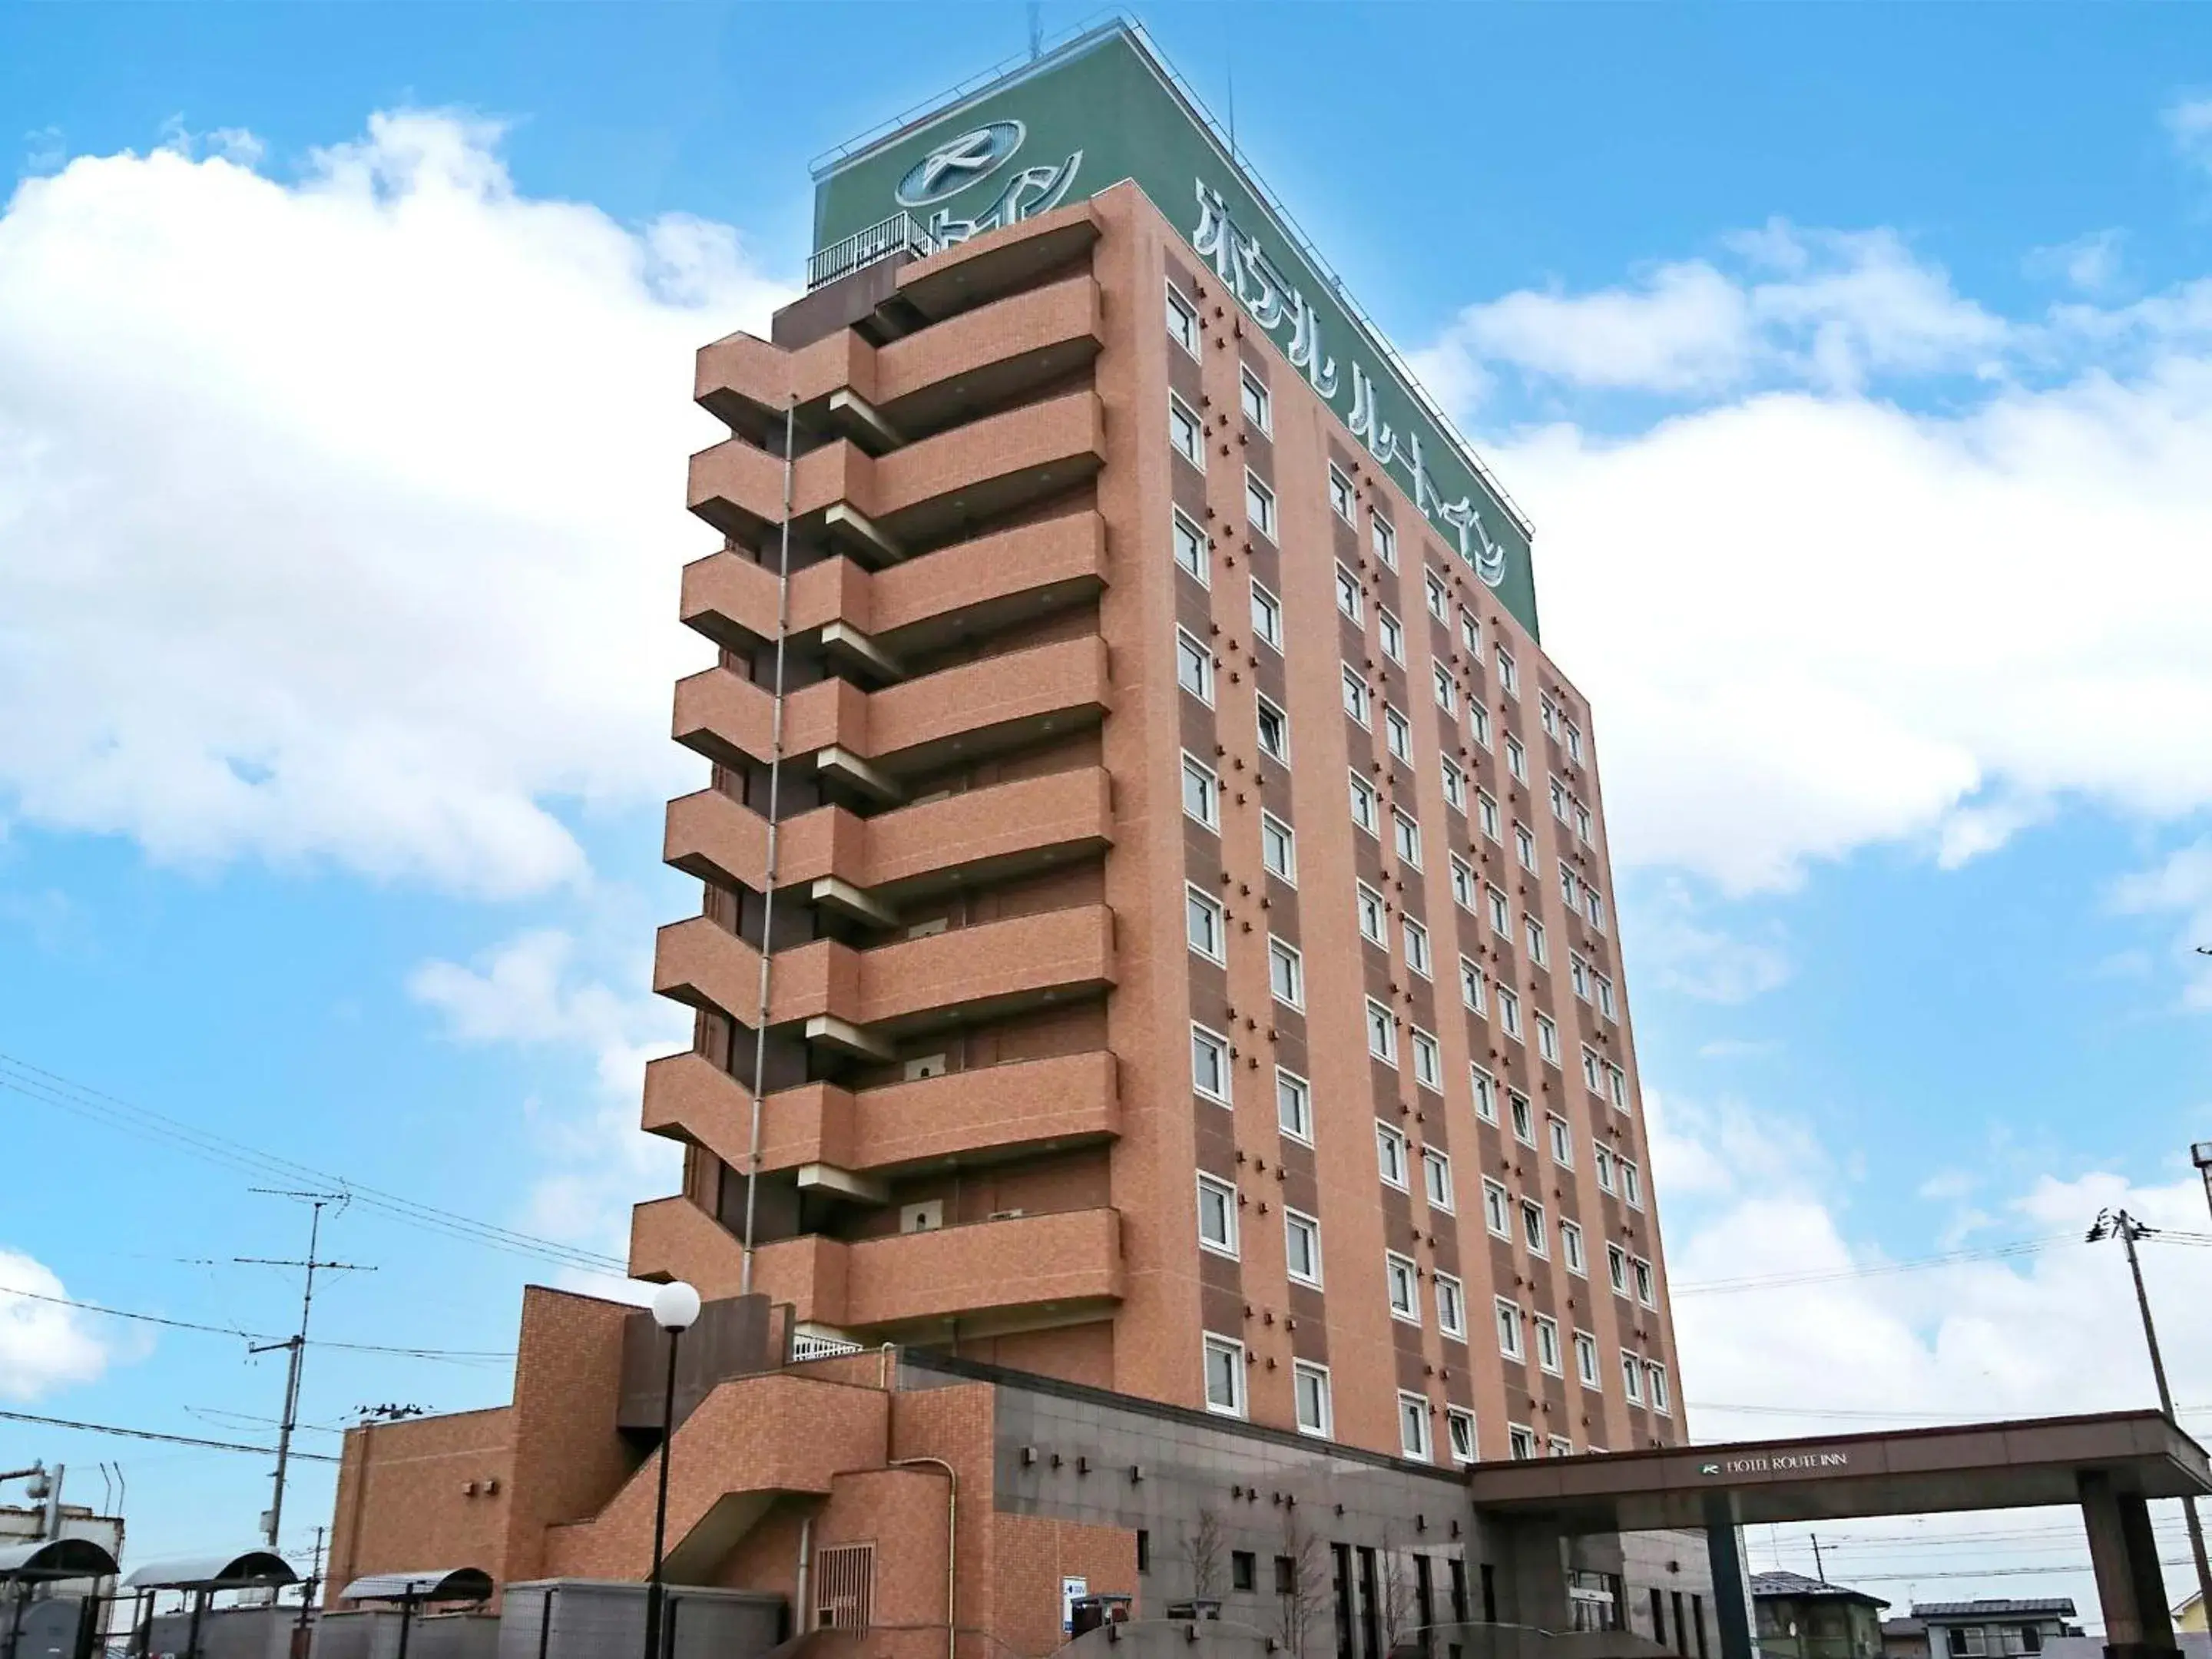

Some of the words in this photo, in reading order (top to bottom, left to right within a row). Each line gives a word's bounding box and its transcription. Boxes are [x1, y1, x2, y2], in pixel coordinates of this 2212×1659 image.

[1727, 1459, 1768, 1472] HOTEL
[1772, 1455, 1818, 1470] ROUTE
[1820, 1453, 1847, 1466] INN
